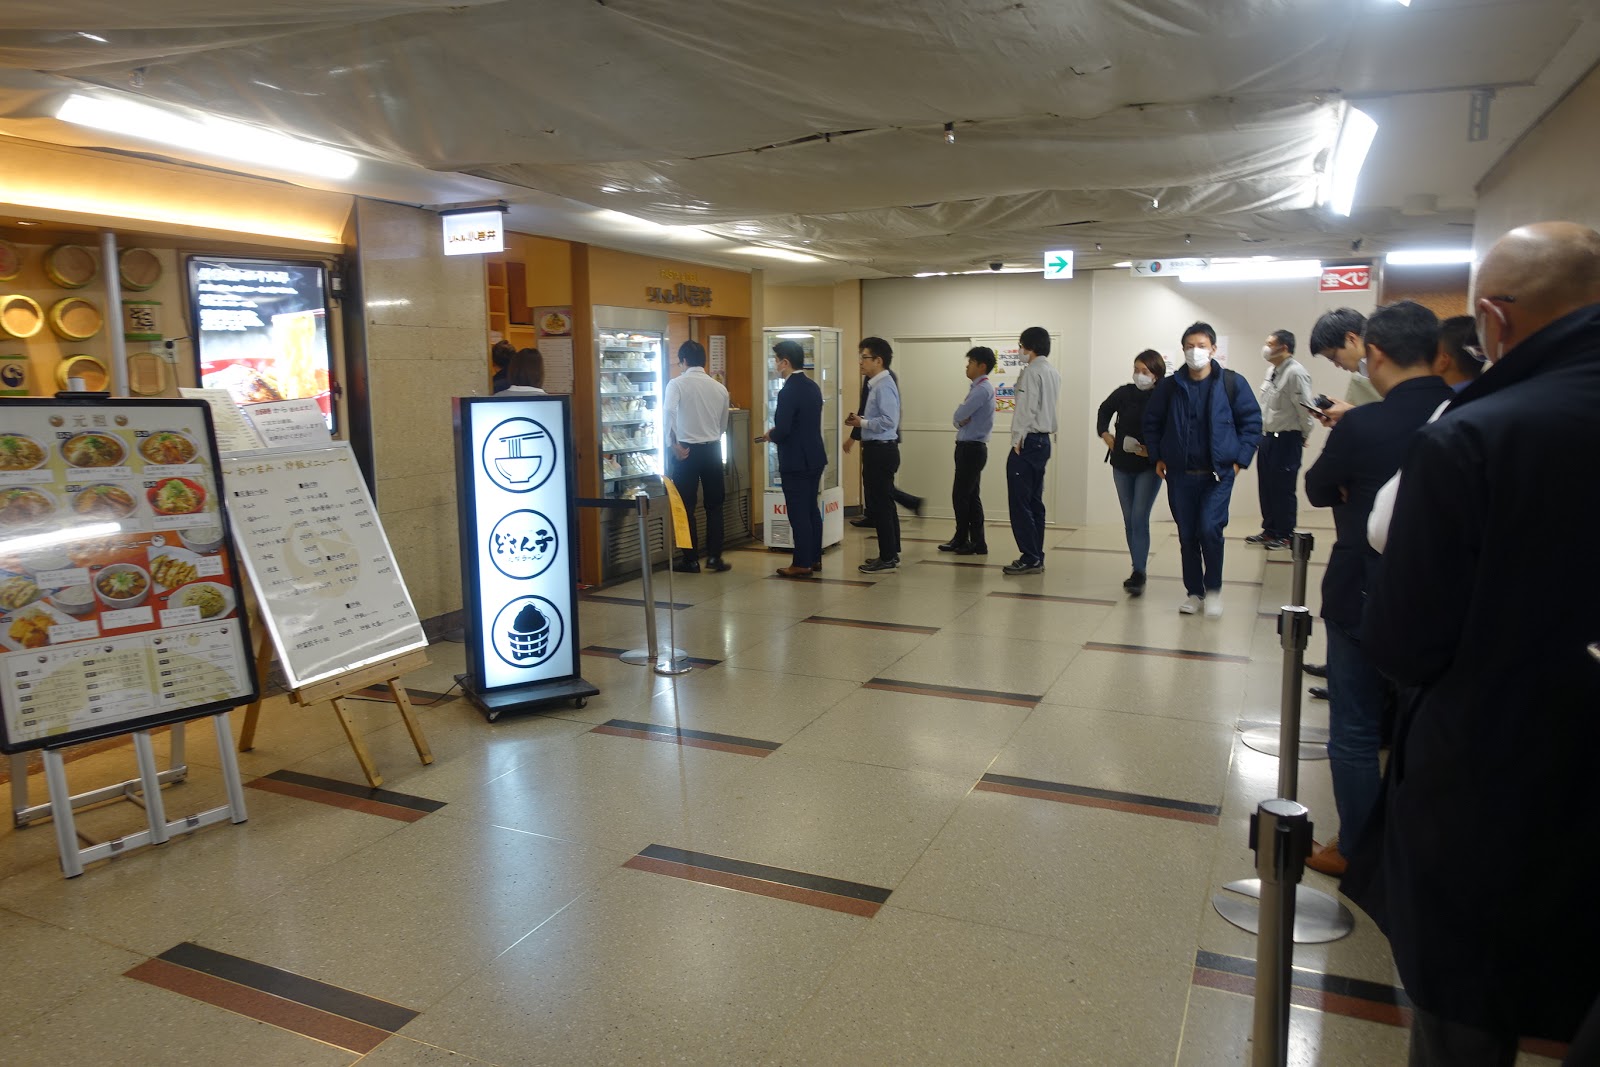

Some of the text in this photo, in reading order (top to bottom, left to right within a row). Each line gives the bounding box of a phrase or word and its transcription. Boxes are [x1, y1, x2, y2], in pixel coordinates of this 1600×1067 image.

[1322, 271, 1369, 287] 宝くじ
[495, 529, 553, 555] どさん子
